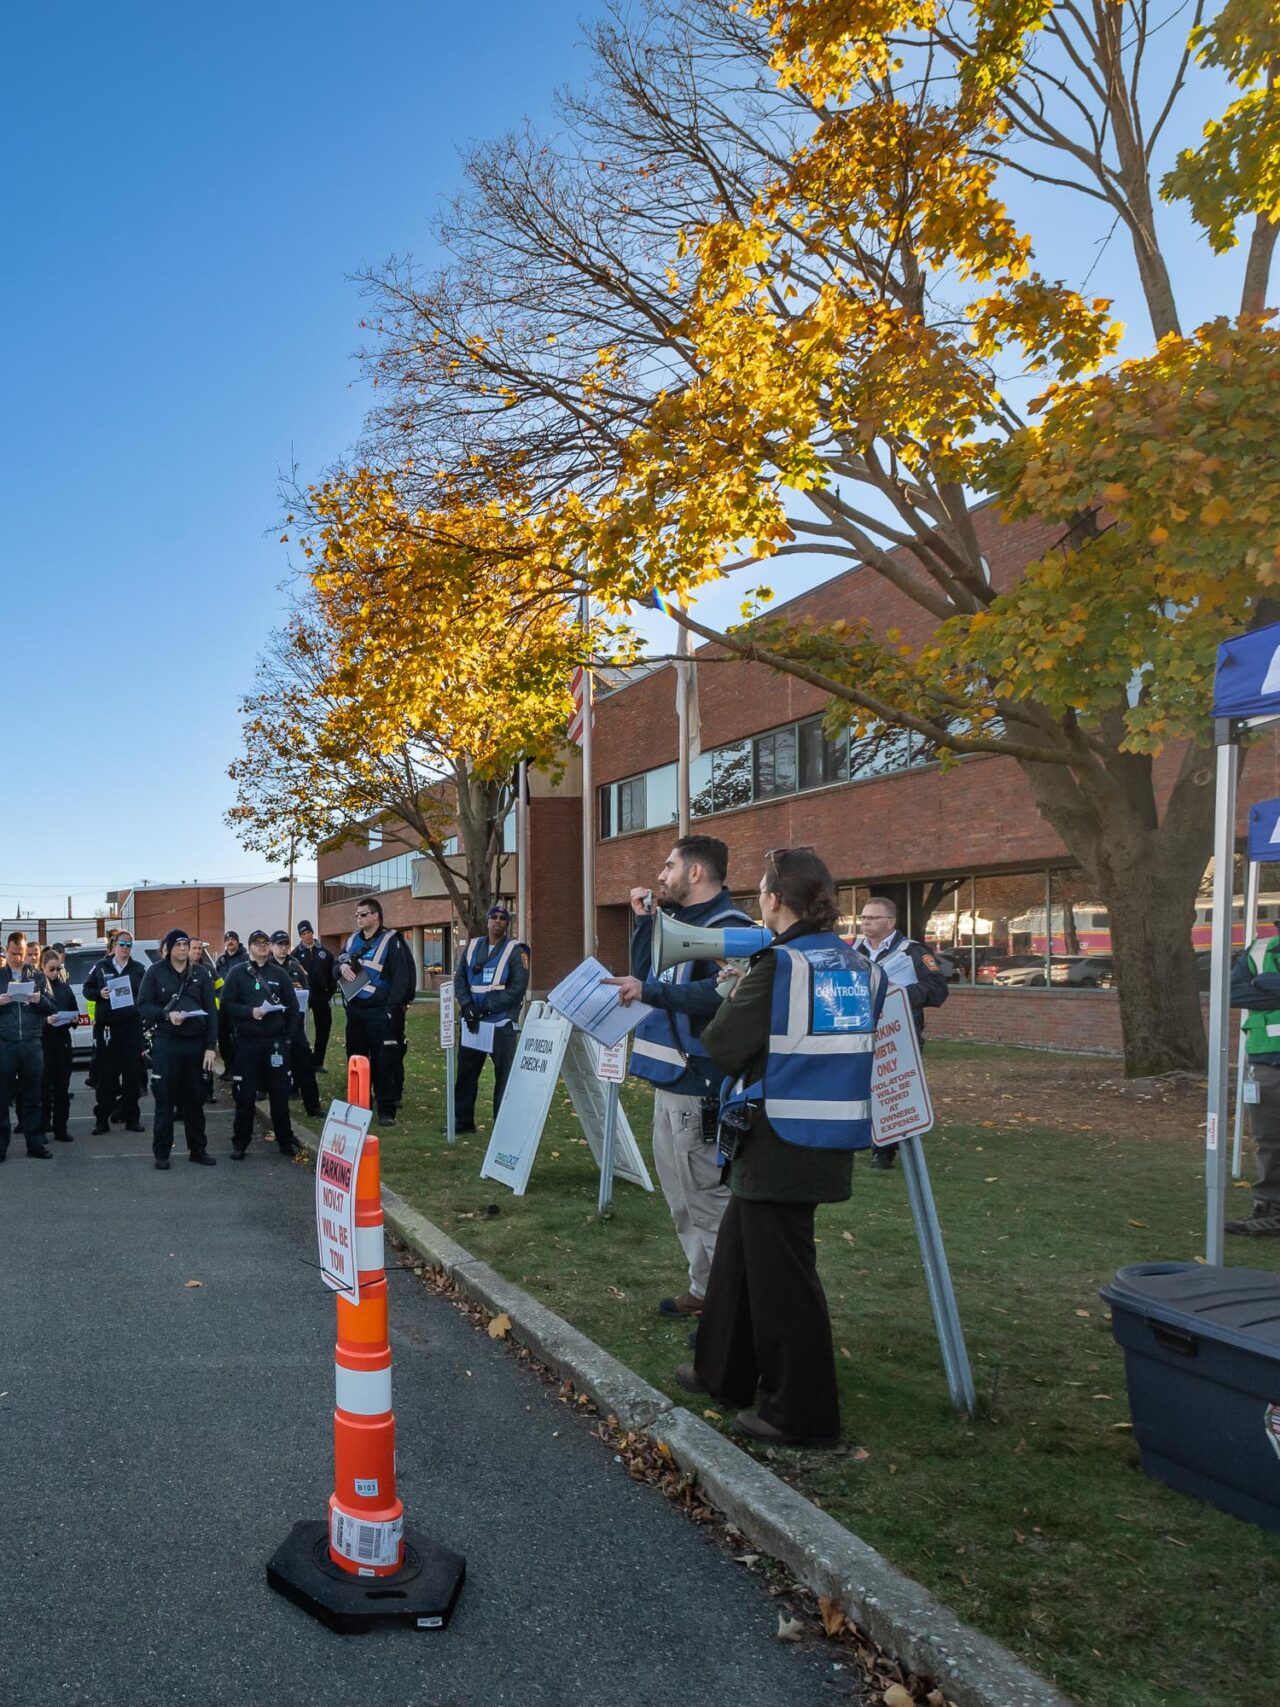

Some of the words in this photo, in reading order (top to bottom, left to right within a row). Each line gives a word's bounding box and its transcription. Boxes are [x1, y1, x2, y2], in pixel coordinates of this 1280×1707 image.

[815, 985, 870, 998] CONTROLLER
[875, 1019, 901, 1042] RKING
[524, 1037, 553, 1055] VIP/MEDIA
[520, 1055, 548, 1073] CHECK-IN
[877, 1058, 897, 1077] ONLY
[870, 1070, 916, 1093] VIOLATORS
[877, 1087, 896, 1099] WILL
[899, 1081, 911, 1091] BE
[879, 1091, 909, 1107] TOWED
[889, 1103, 899, 1112] AT
[880, 1106, 916, 1124] OWNERS
[881, 1114, 920, 1133] EXPENSE
[331, 1133, 347, 1155] NO
[320, 1155, 352, 1188] PARKING
[322, 1186, 345, 1214] NOV.17
[322, 1217, 338, 1243] WILL
[339, 1224, 349, 1249] BE
[329, 1248, 345, 1275] TOW
[357, 1484, 376, 1492] B103
